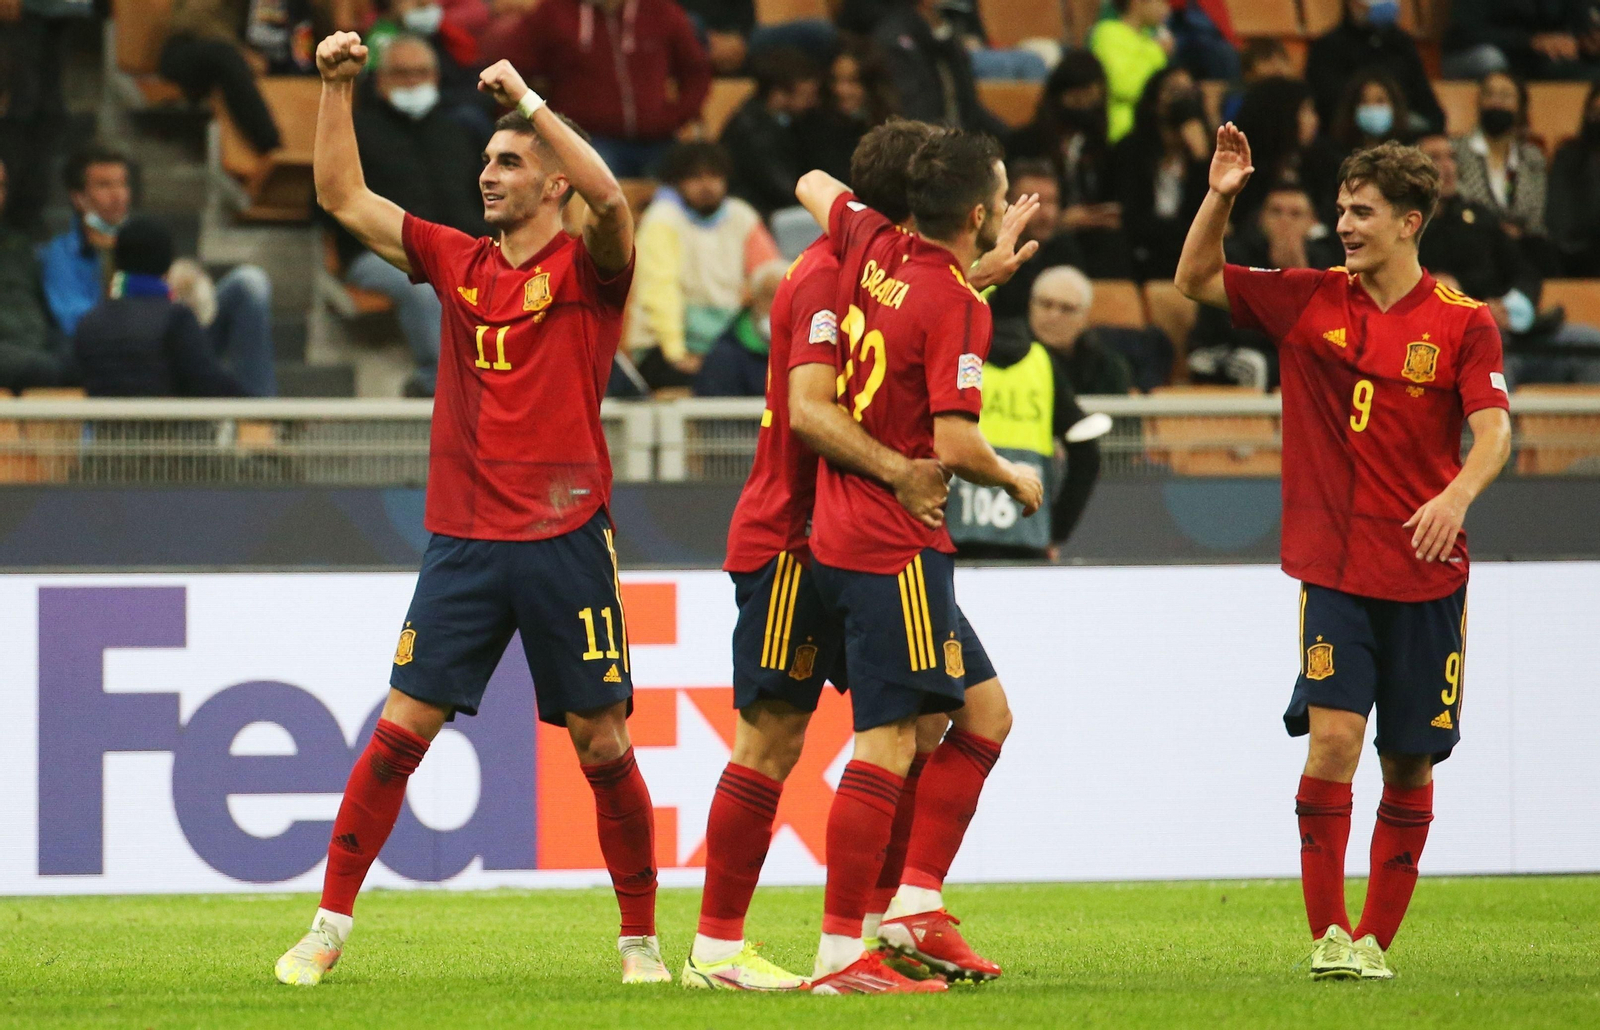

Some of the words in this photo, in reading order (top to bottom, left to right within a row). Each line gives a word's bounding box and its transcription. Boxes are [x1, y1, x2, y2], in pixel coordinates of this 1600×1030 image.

[475, 325, 512, 370] 11
[1349, 379, 1374, 433] 9
[959, 485, 1017, 529] 106
[578, 606, 620, 660] 11
[1441, 651, 1460, 706] 9
